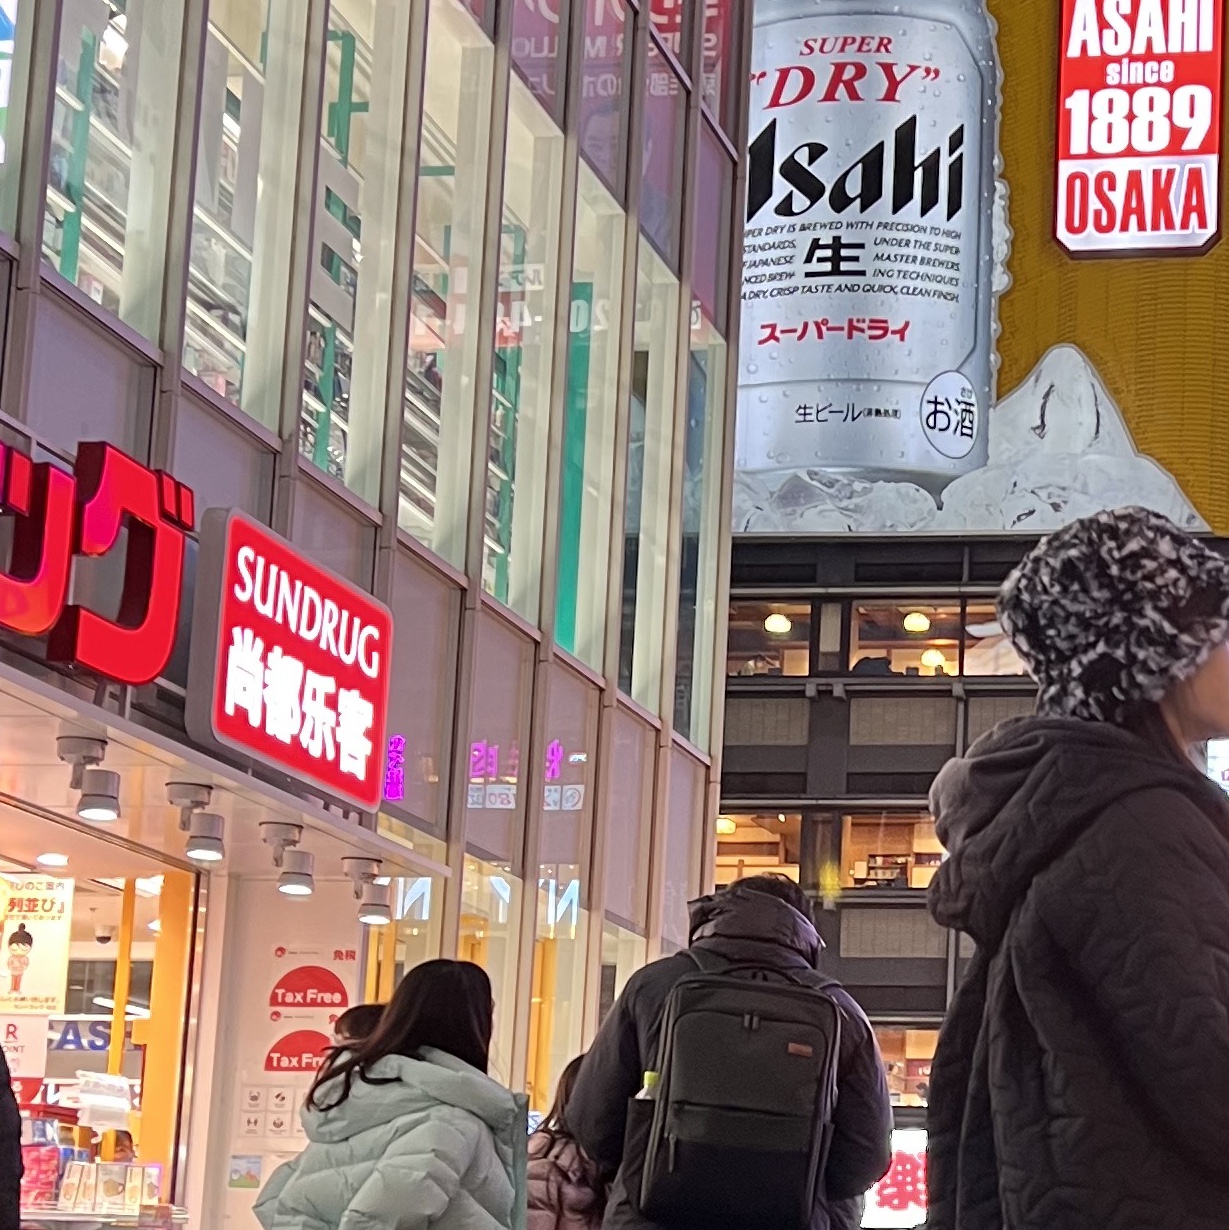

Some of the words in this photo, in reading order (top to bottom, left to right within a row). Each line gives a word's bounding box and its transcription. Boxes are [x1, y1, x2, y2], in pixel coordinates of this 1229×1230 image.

[1067, 0, 1213, 58] ASAHI
[799, 35, 893, 56] SUPER
[1105, 57, 1175, 85] since
[1065, 84, 1213, 155] 1889
[1064, 167, 1208, 235] OSAKA
[765, 224, 787, 236] DRY
[787, 223, 798, 234] IS
[799, 220, 843, 233] BREWED
[845, 220, 875, 231] WITH
[876, 221, 928, 235] PRECISION
[929, 226, 942, 237] TO
[803, 235, 867, 278] 生
[873, 237, 911, 249] UNDER
[912, 239, 932, 252] THE
[872, 252, 918, 265] MASTER
[872, 268, 895, 278] ING
[896, 269, 960, 287] TECHNIQUES
[770, 285, 800, 298] CRISP
[800, 283, 834, 295] TASTE
[834, 283, 860, 293] AND
[899, 285, 931, 298] CLEAN
[757, 317, 911, 346] スーパードライ
[925, 394, 975, 439] お酒
[234, 545, 380, 679] SUNDRUG
[224, 625, 374, 781] 尚都乐客
[275, 989, 304, 1004] Tax
[306, 989, 342, 1004] Free
[6, 1023, 18, 1040] R
[270, 1053, 299, 1068] Tax
[301, 1053, 327, 1068] Fr
